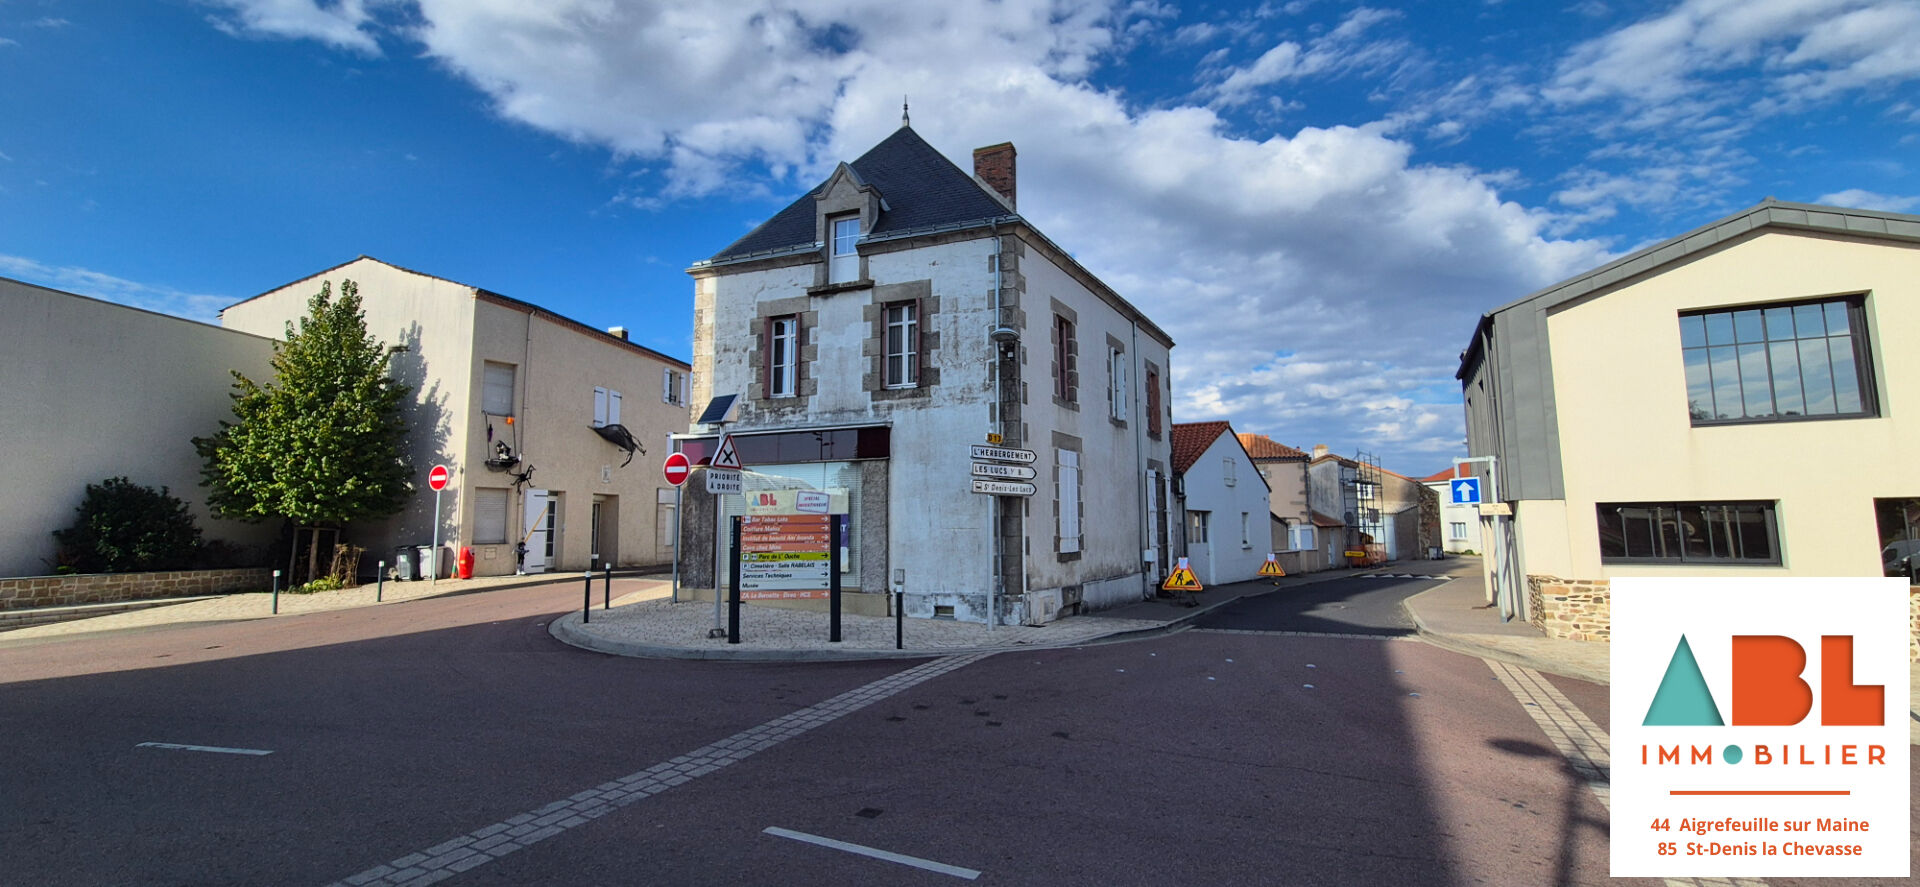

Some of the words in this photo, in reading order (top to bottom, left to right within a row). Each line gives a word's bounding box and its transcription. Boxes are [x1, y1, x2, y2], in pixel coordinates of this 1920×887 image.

[974, 448, 1031, 460] L'HERBERGEMENT
[975, 465, 987, 473] LES
[990, 466, 1007, 475] LUCS
[717, 483, 740, 491] DROITE
[752, 493, 777, 506] ABL
